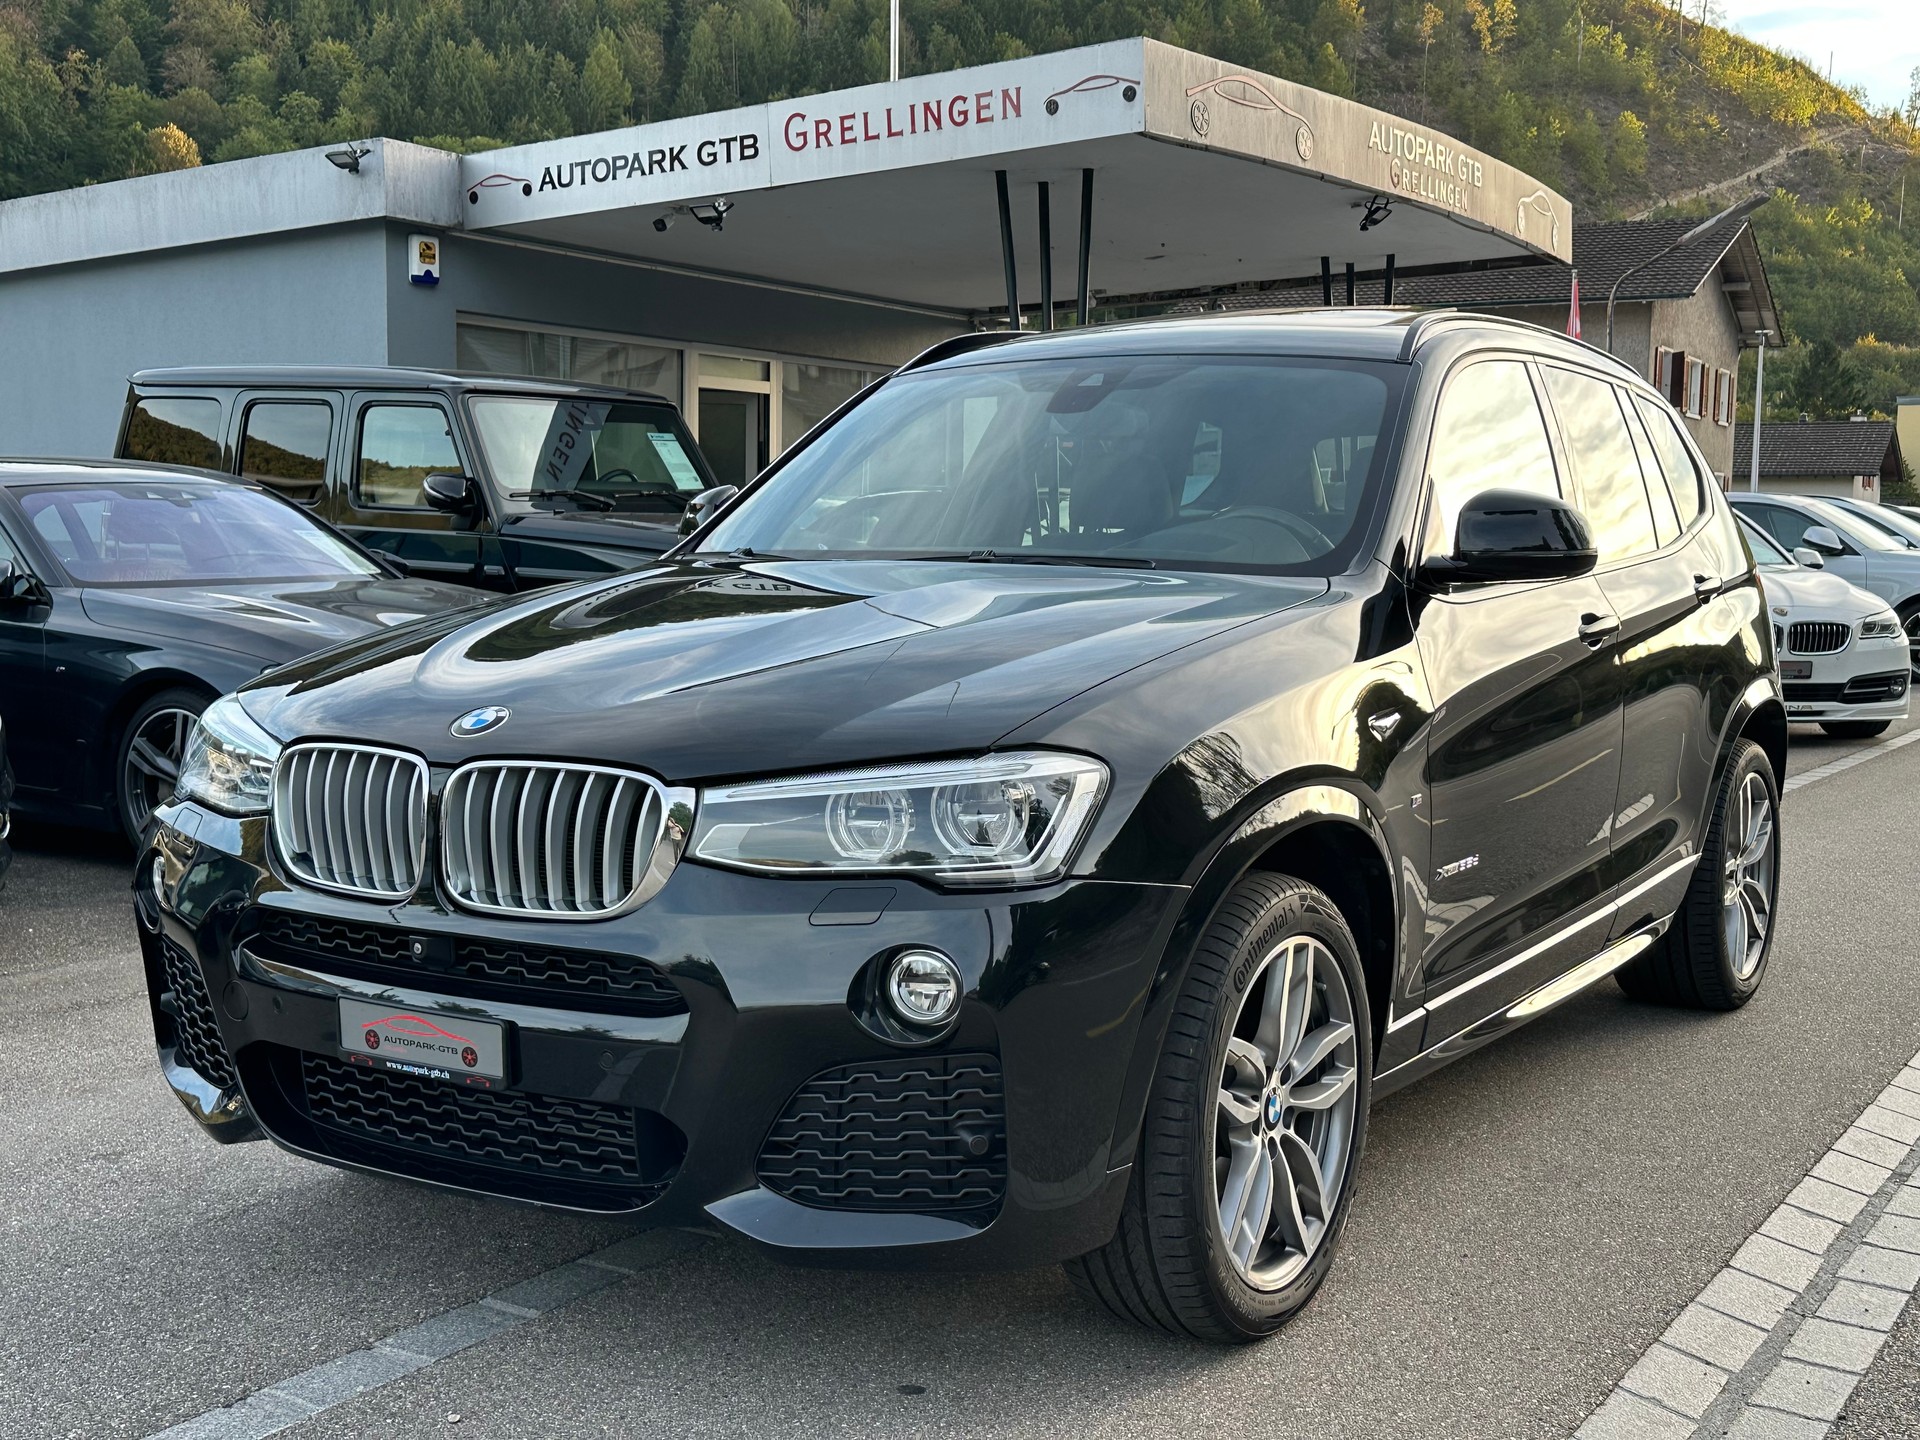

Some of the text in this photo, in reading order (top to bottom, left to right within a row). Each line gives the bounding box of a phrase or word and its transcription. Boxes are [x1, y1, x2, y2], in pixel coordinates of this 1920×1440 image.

[538, 86, 1022, 192] AUTOPARK GTB GRELLINGEN
[1367, 121, 1483, 188] AUTOPARK GTB
[1389, 158, 1468, 212] GRELLINGEN
[1233, 906, 1288, 994] Continental
[384, 1035, 458, 1055] AUTOPARK-GTB
[386, 1061, 450, 1079] www.autopark-gtb.ch
